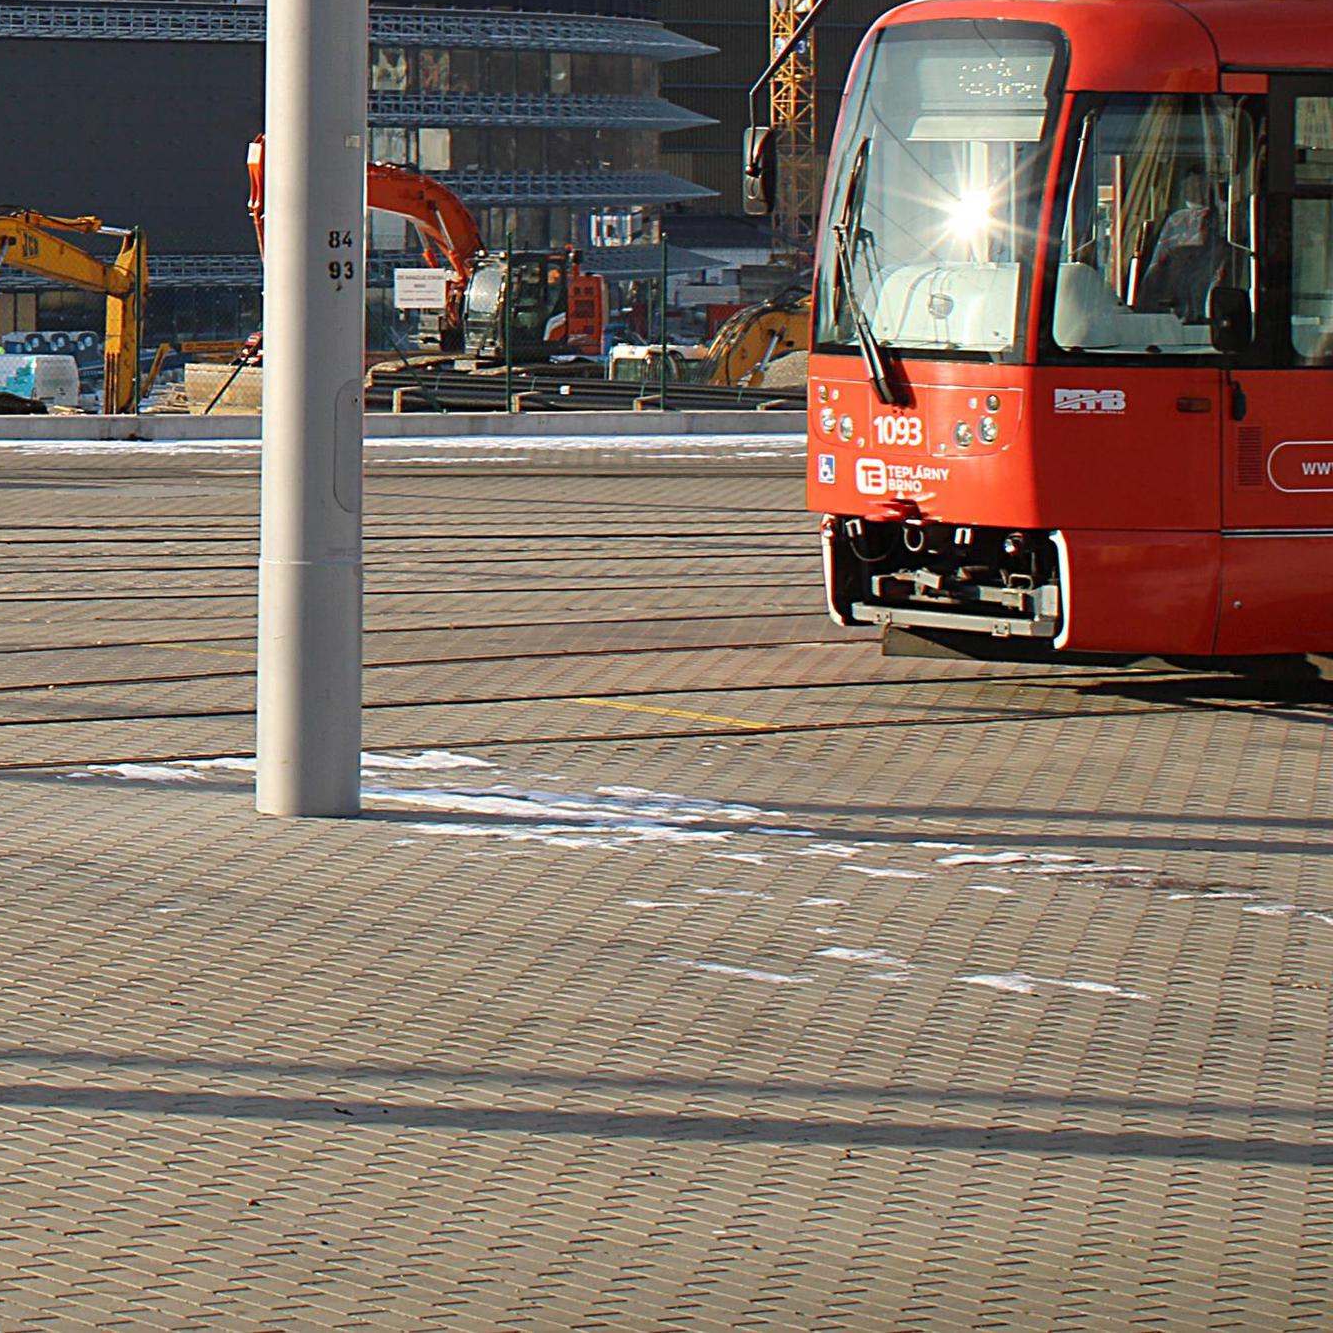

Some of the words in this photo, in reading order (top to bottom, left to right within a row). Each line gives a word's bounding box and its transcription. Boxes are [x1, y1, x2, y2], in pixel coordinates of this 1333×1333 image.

[329, 230, 353, 249] 84
[328, 261, 354, 280] 93
[873, 415, 923, 446] 1093
[887, 464, 949, 481] TEPLÁRNY
[888, 478, 922, 493] BRNO
